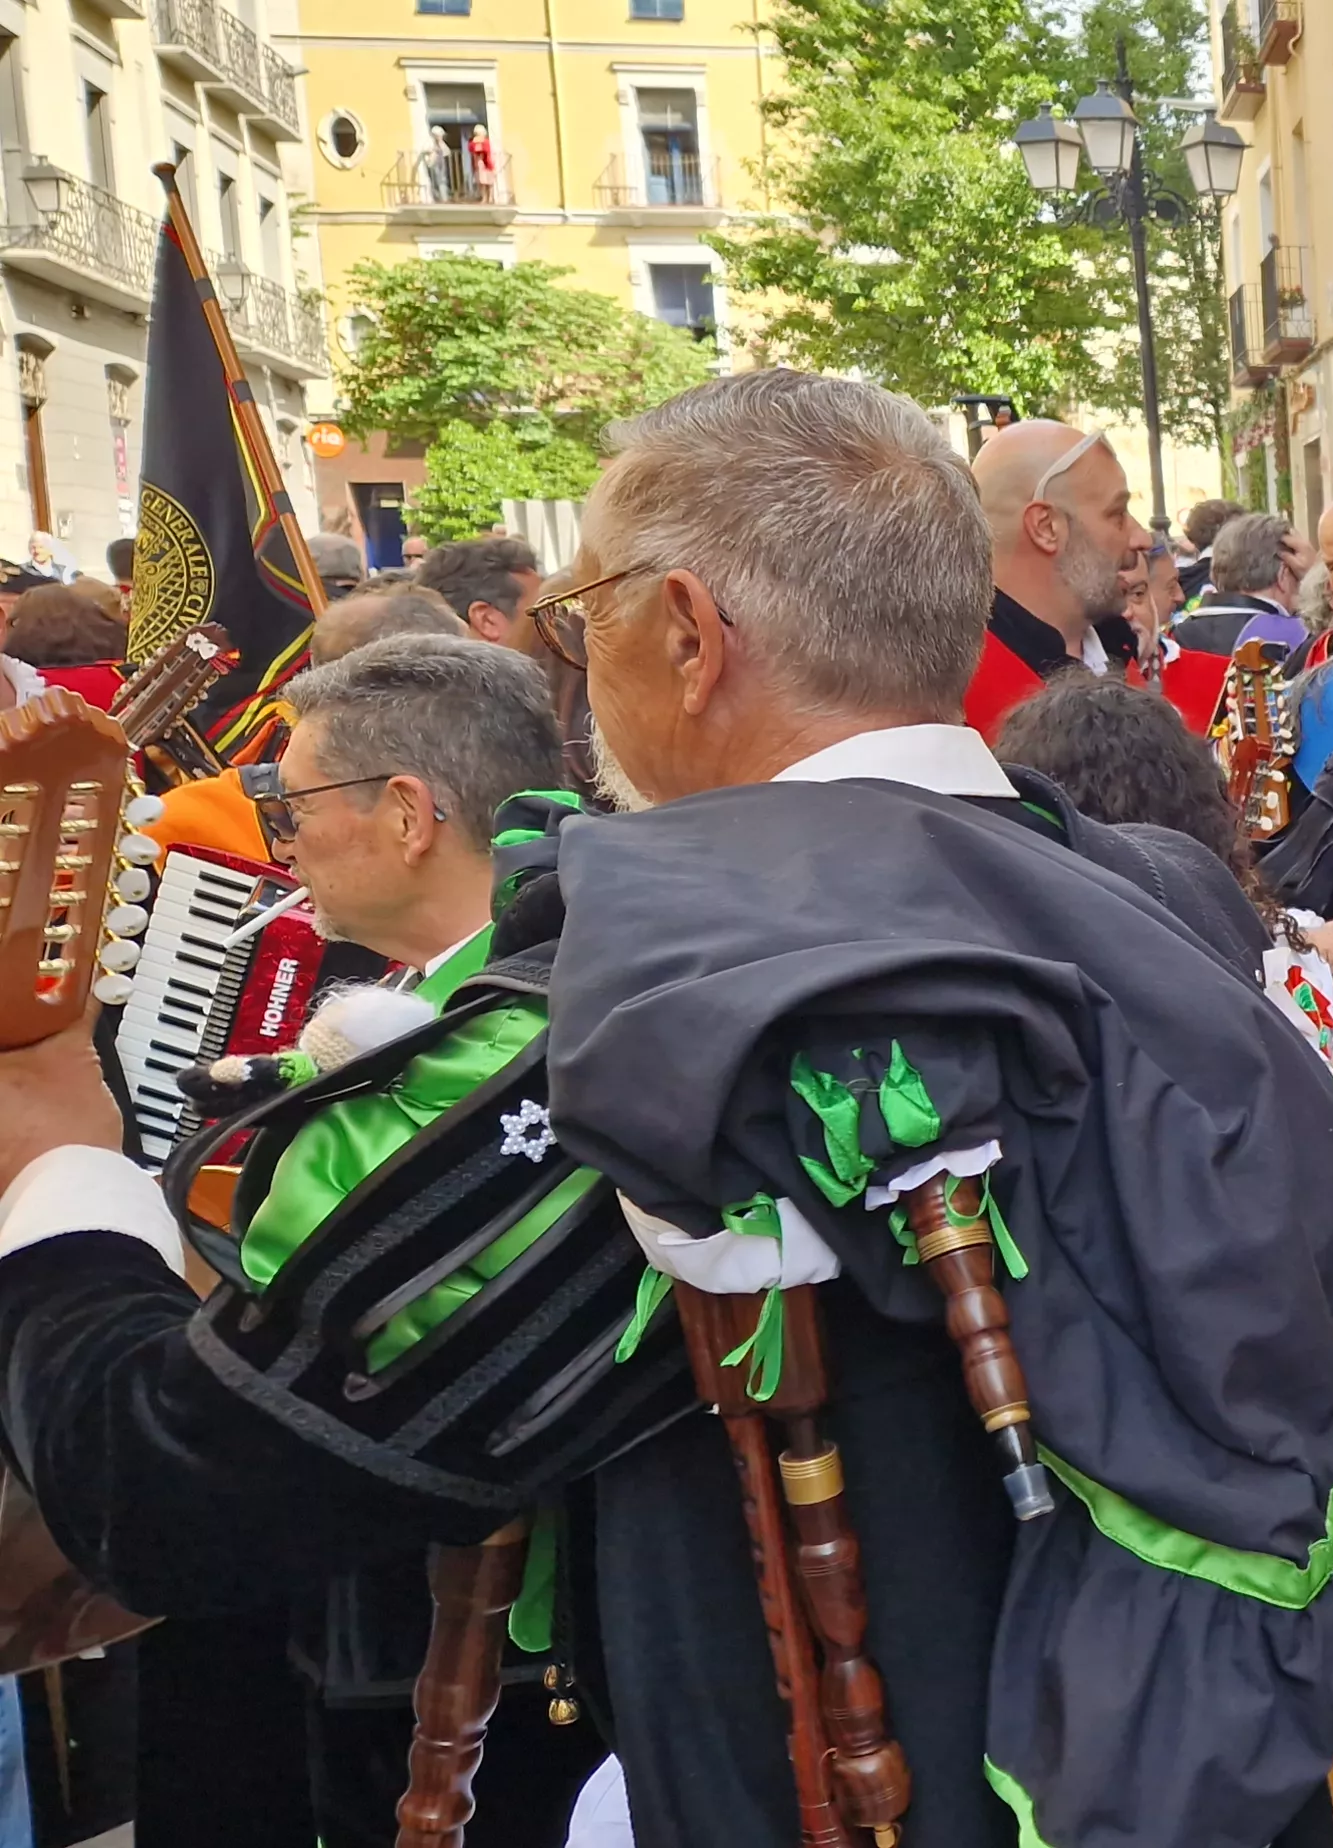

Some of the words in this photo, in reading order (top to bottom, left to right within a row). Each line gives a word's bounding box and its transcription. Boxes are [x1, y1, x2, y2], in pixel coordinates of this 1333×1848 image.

[312, 427, 341, 445] ria
[141, 489, 208, 577] GENERALE
[259, 957, 300, 1037] HOHNER
